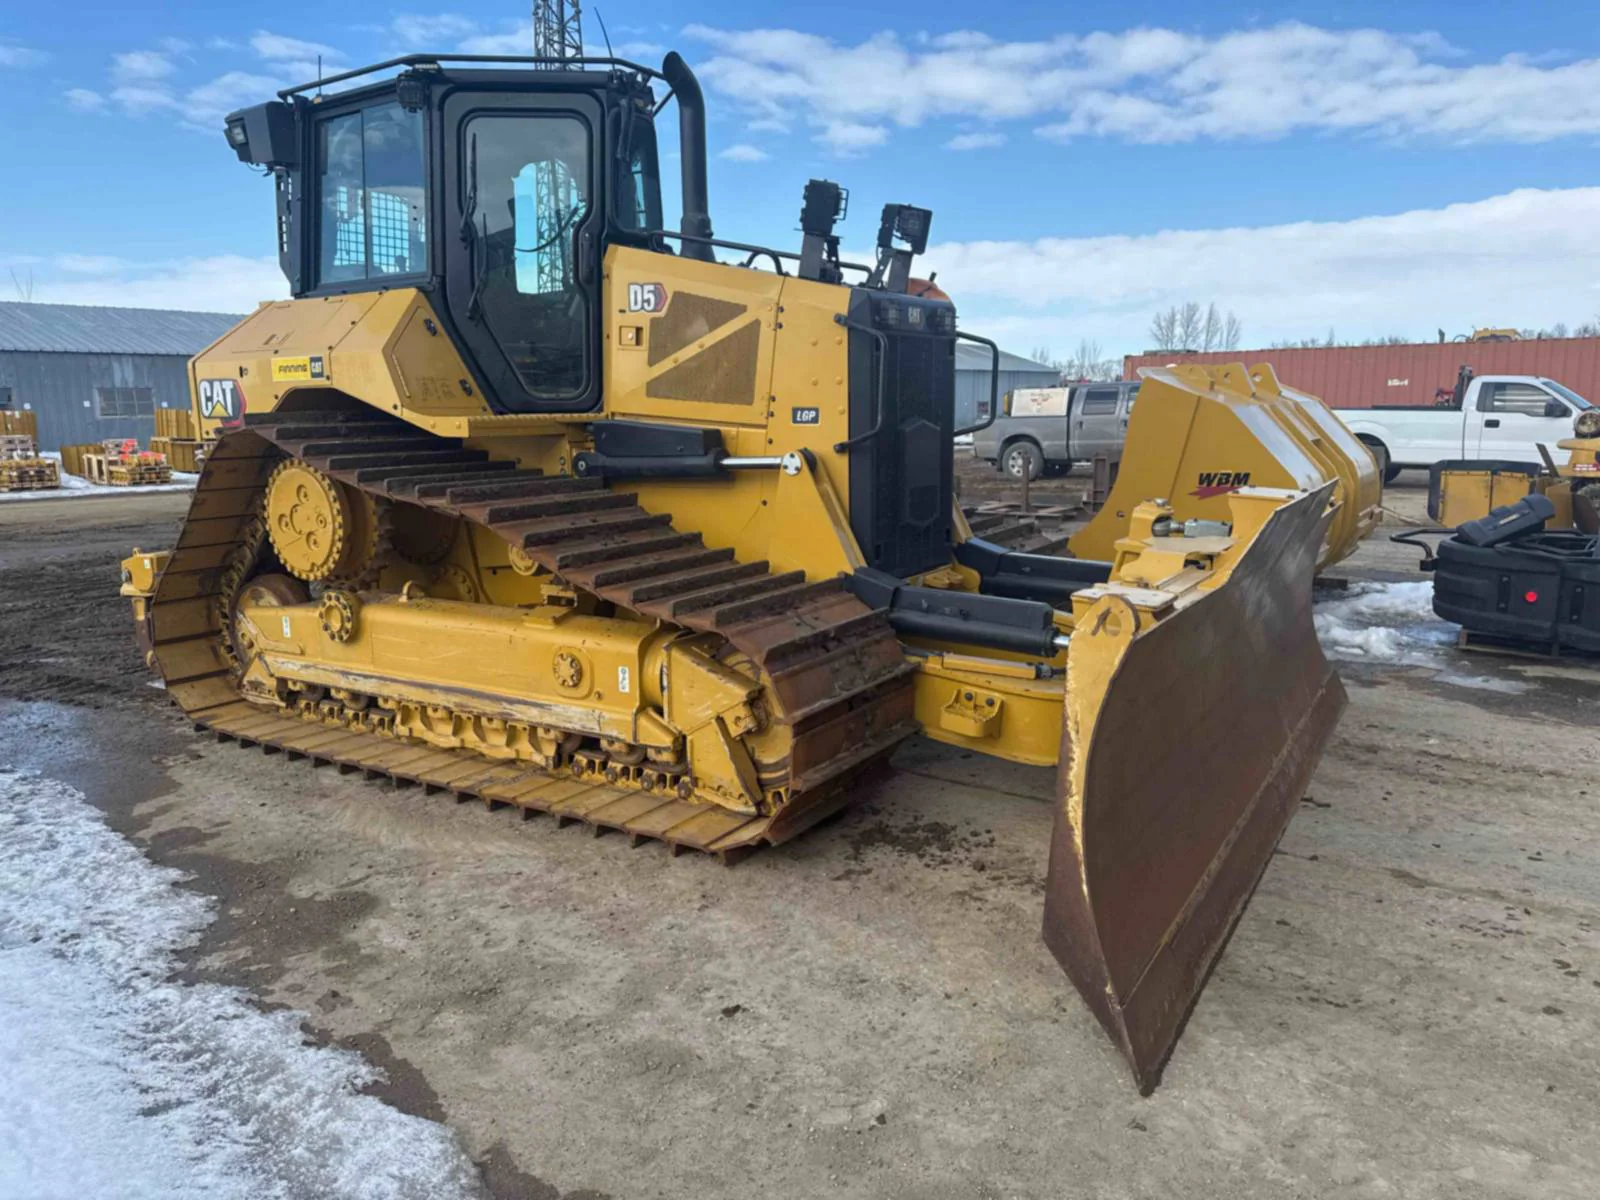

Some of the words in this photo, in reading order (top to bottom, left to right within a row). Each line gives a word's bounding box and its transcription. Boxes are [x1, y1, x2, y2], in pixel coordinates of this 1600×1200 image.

[630, 284, 655, 310] D5
[311, 362, 322, 373] CAT
[200, 380, 233, 417] CAT
[796, 410, 816, 422] LGP
[1198, 472, 1251, 487] WBM
